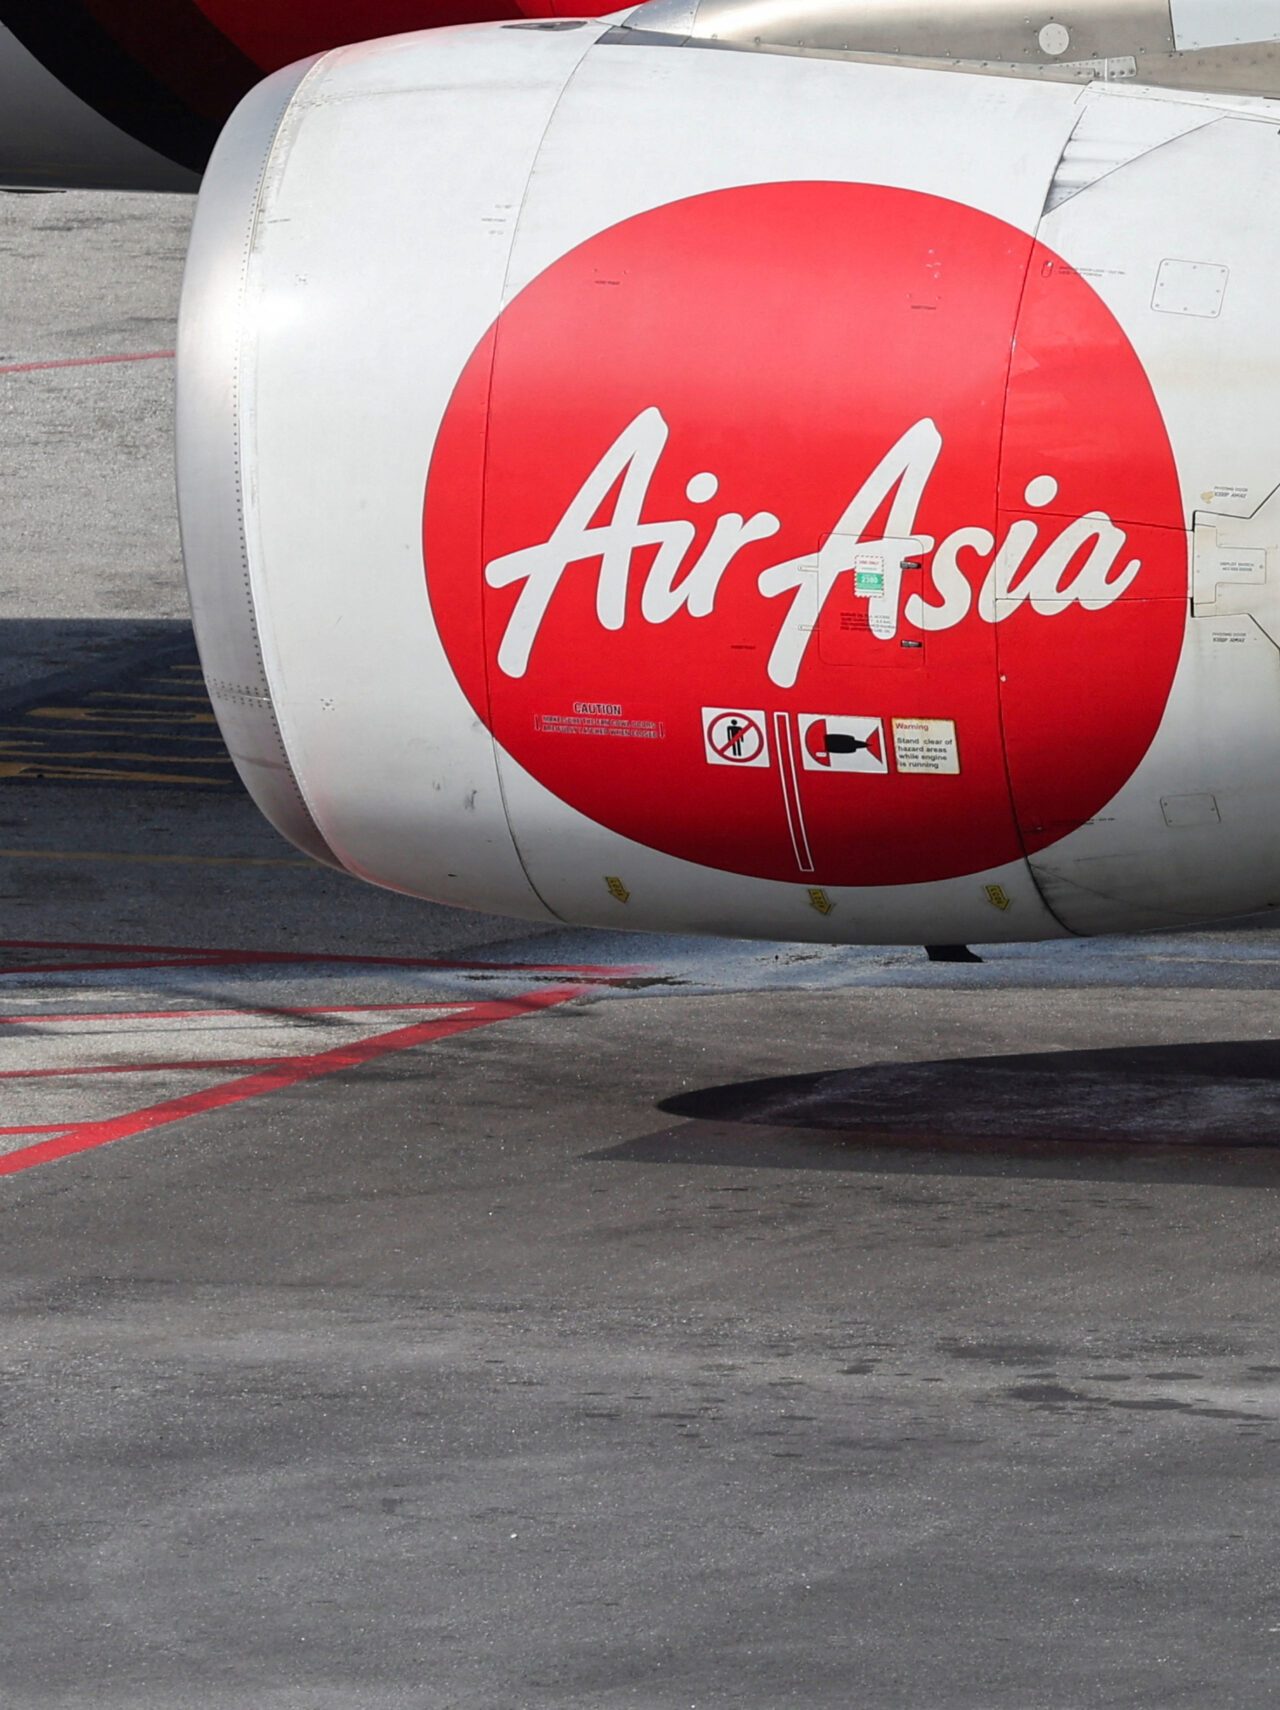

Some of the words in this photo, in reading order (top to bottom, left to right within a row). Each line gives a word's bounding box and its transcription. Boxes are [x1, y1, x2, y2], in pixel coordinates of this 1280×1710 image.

[573, 702, 622, 715] CAUTION
[896, 723, 929, 731] Warning
[897, 737, 919, 745] Stand
[909, 762, 939, 770] running
